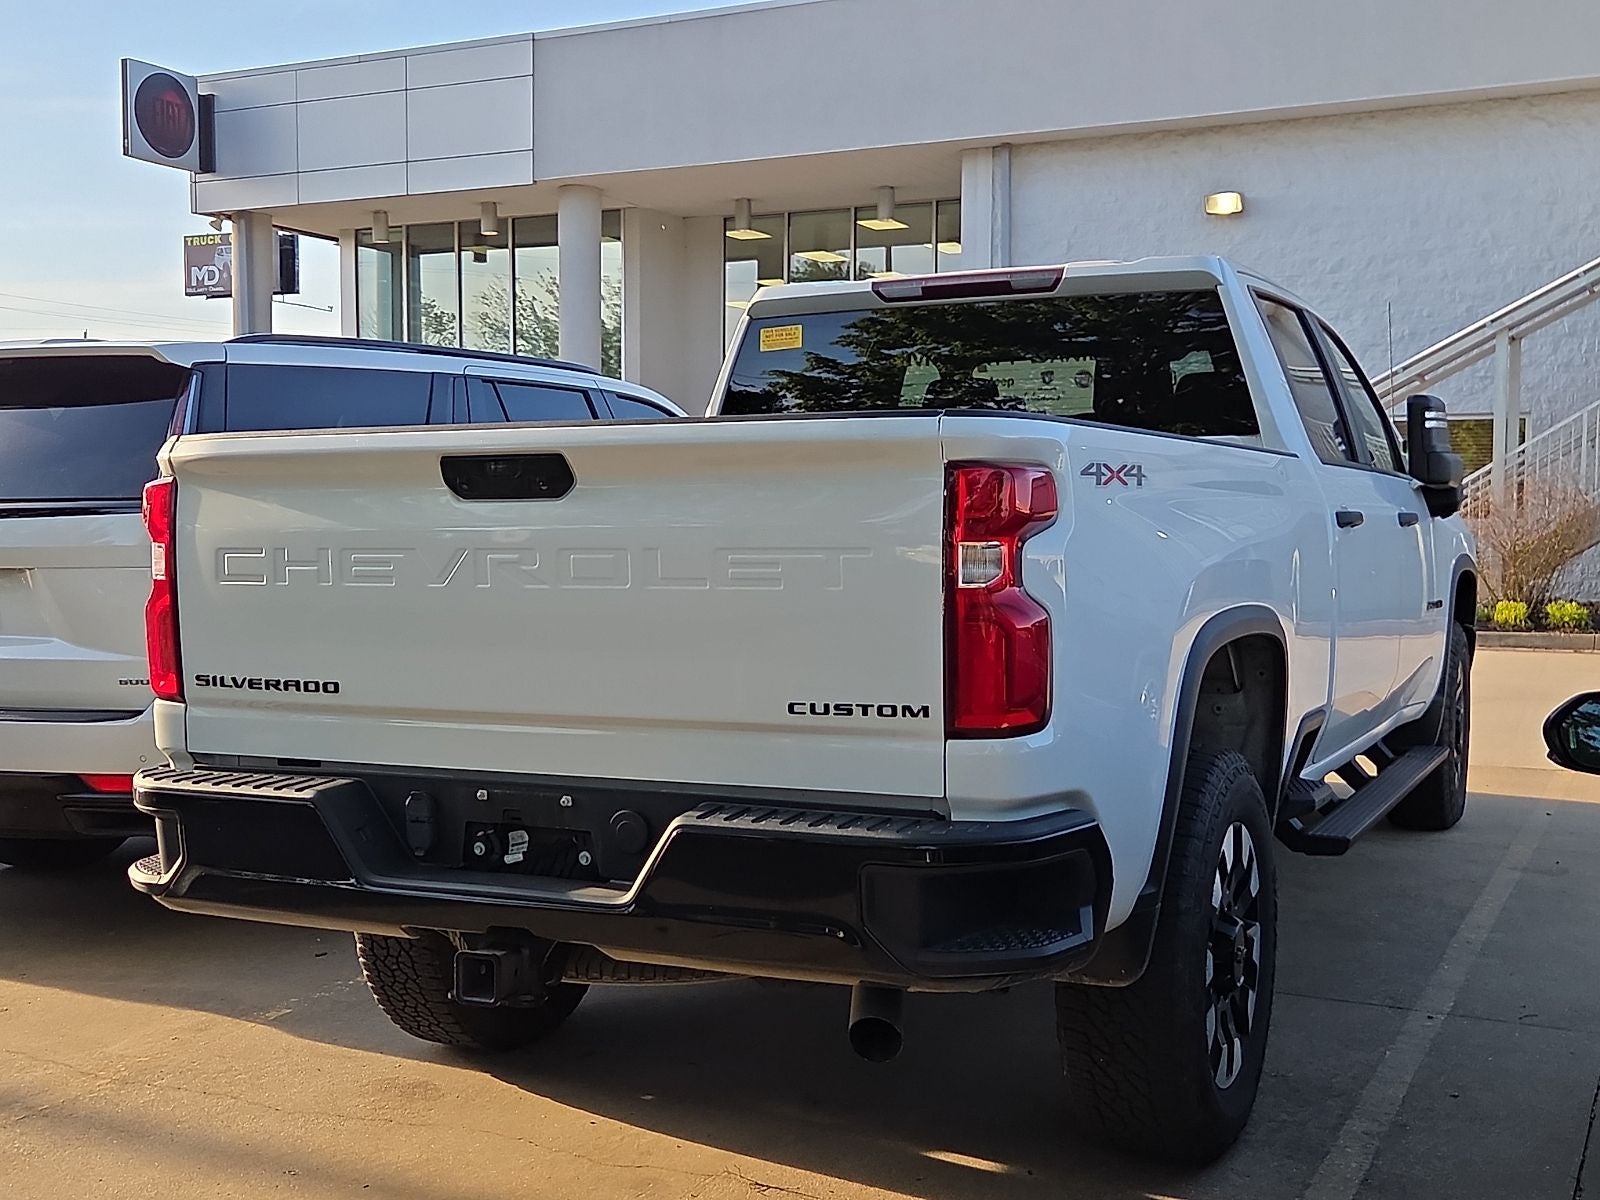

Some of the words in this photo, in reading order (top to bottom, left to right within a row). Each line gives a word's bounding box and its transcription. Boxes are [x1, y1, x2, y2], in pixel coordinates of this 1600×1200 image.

[186, 235, 222, 246] TRUCK
[191, 265, 220, 287] MD
[1080, 462, 1147, 487] 4X4
[216, 547, 873, 590] CHEVROLET
[194, 673, 341, 694] SILVERADO
[787, 701, 930, 718] CUSTOM
